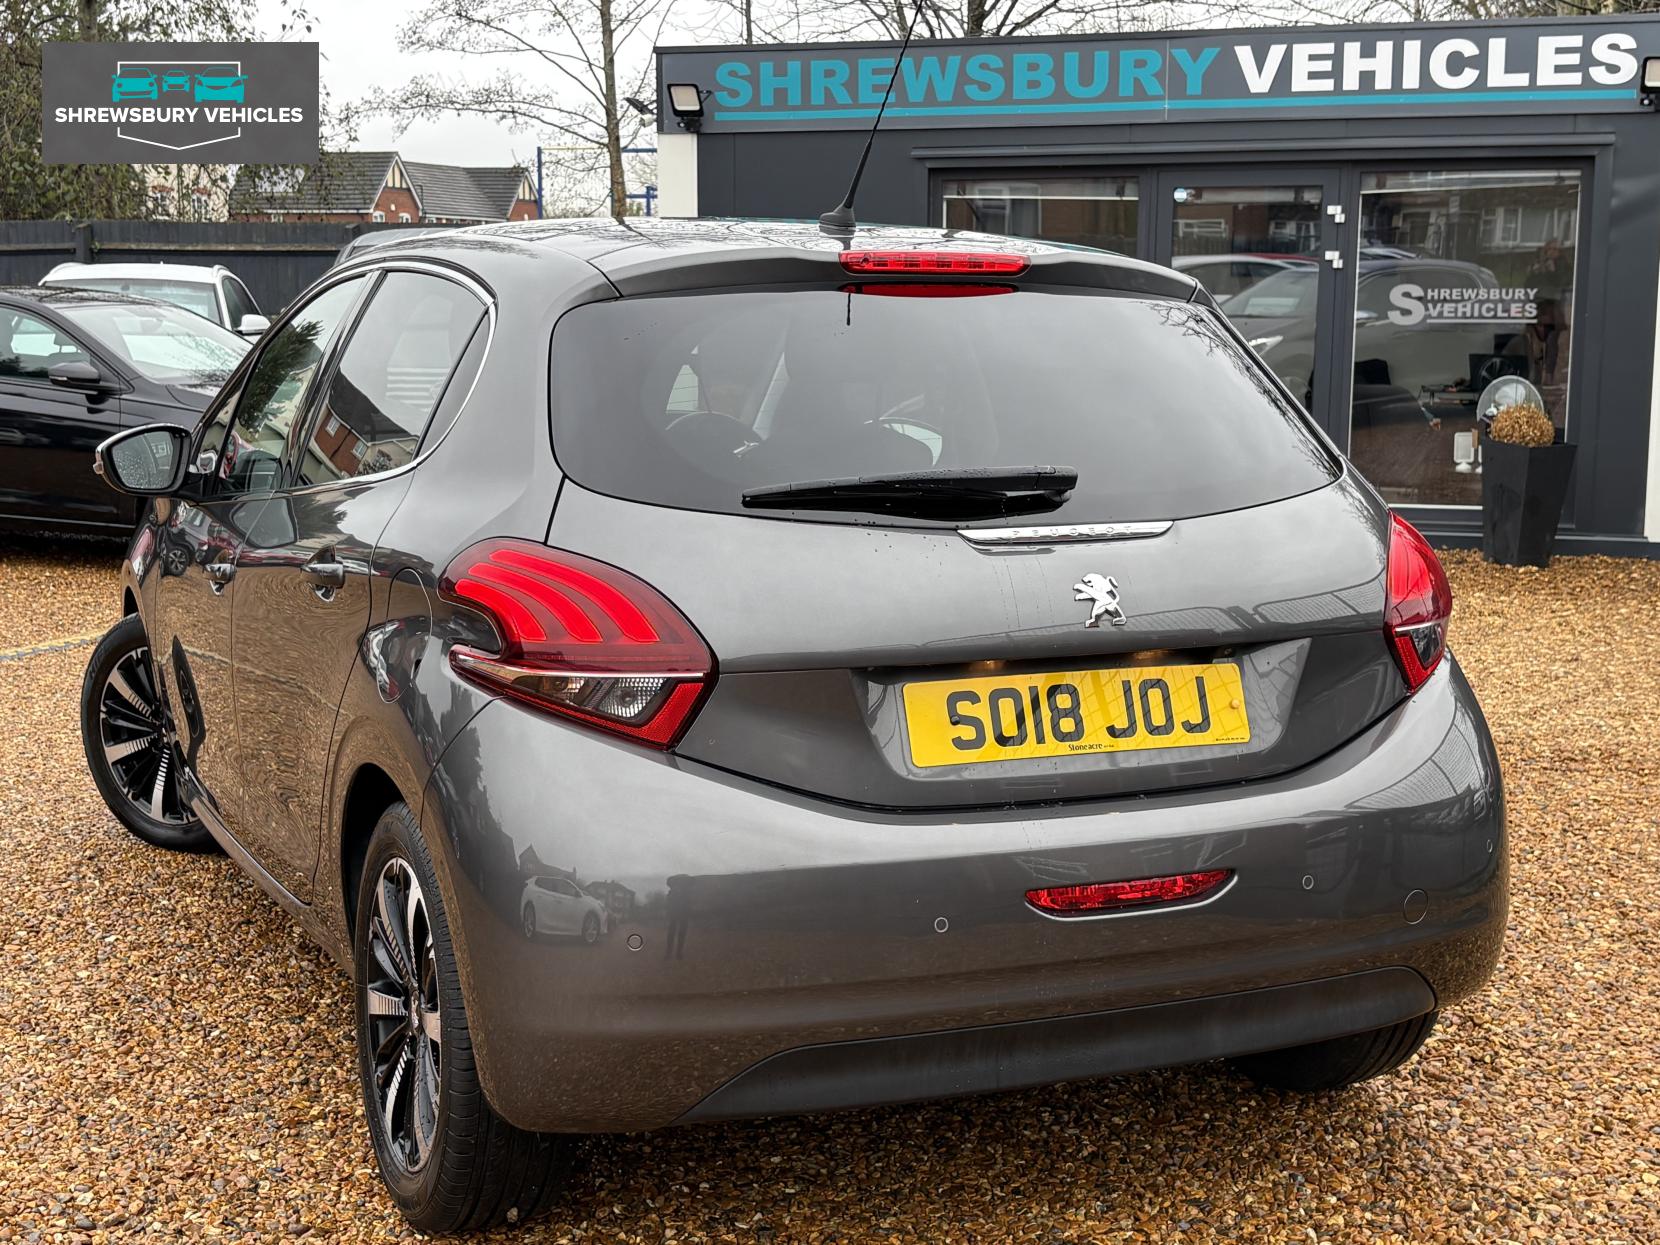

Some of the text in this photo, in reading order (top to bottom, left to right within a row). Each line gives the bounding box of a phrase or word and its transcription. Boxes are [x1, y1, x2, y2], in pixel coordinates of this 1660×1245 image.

[714, 33, 1638, 107] SHREWSBURY VEHICLES
[1387, 284, 1538, 326] SHREWSBURY
[1427, 303, 1538, 318] VEHICLES
[946, 676, 1212, 751] SO18 JOJ
[1068, 743, 1103, 752] Stoneacre
